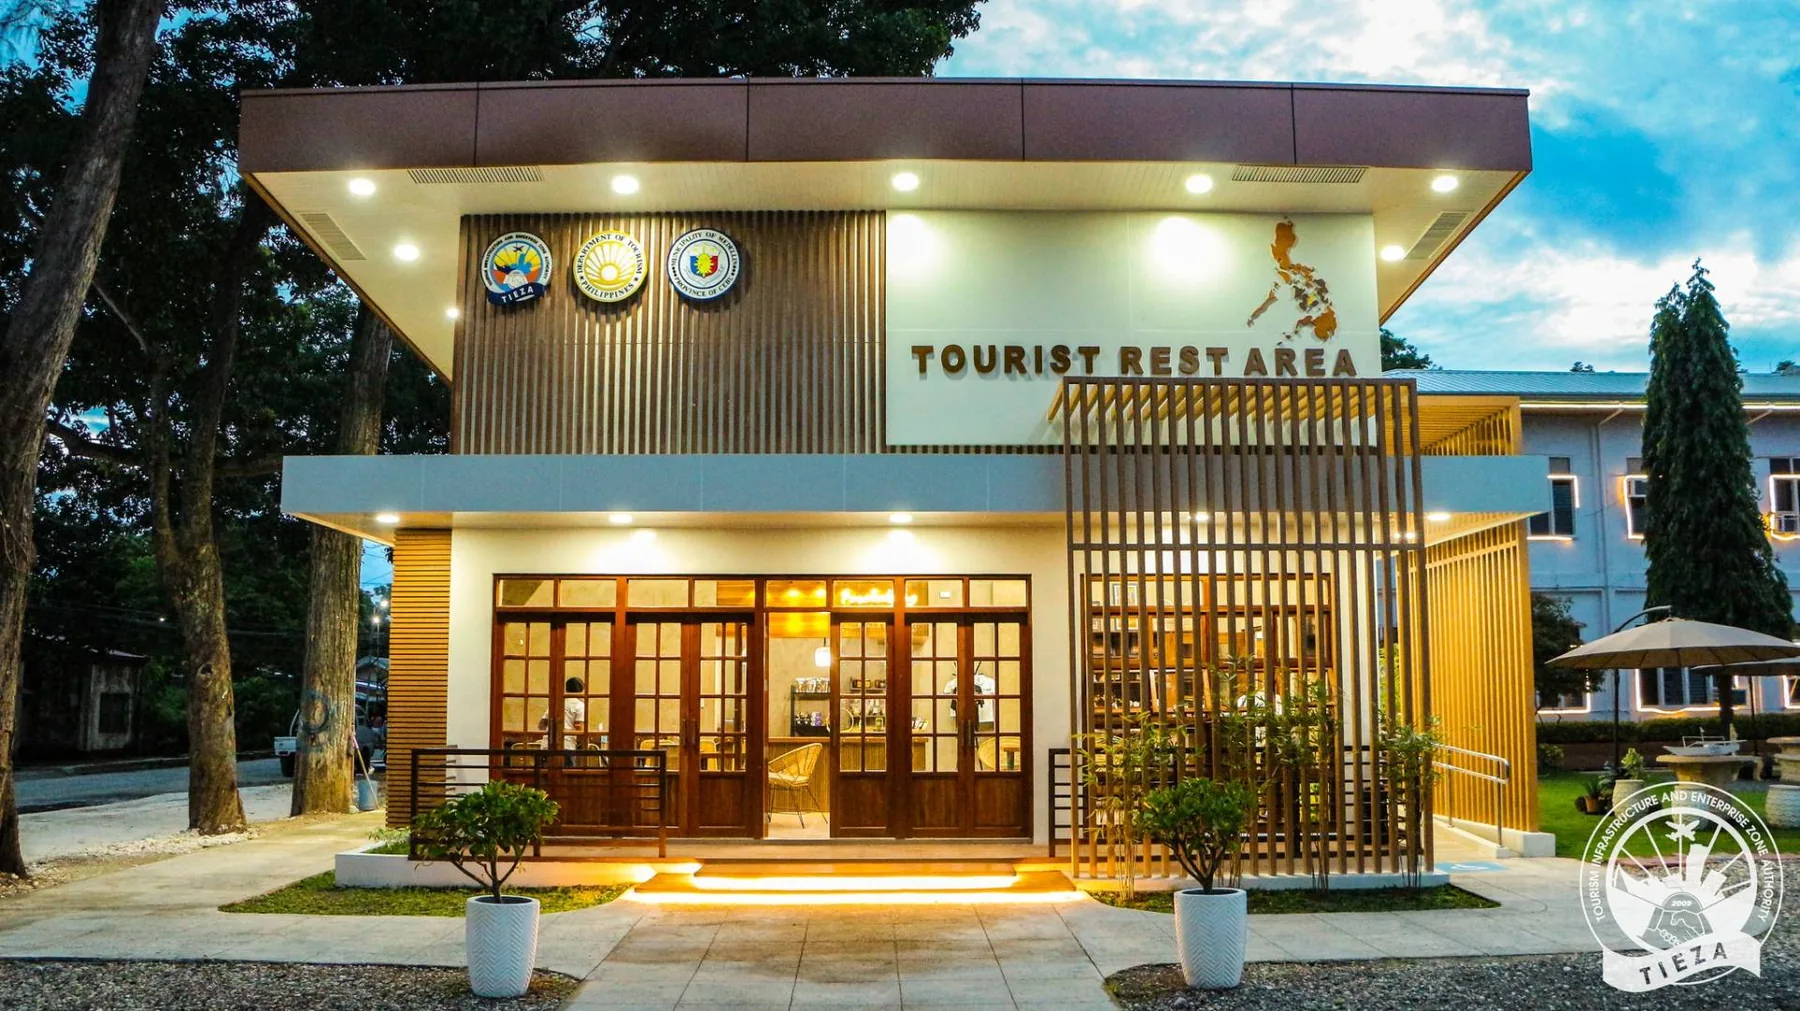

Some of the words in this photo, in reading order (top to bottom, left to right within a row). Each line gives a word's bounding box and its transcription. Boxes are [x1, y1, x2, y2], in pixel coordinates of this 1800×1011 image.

[576, 233, 612, 274] DEPARTMENT
[614, 233, 625, 242] OF
[627, 239, 643, 275] TOURISM
[671, 231, 703, 268] MUNICIPALITY
[705, 231, 717, 239] OF
[501, 285, 534, 304] TIEZA
[580, 280, 634, 299] PHILIPPINES
[674, 275, 707, 297] PROVINCE
[708, 288, 718, 297] OF
[718, 275, 734, 292] CEBU
[911, 345, 1100, 374] TOURIST
[1120, 346, 1229, 374] REST
[1243, 347, 1358, 376] AREA
